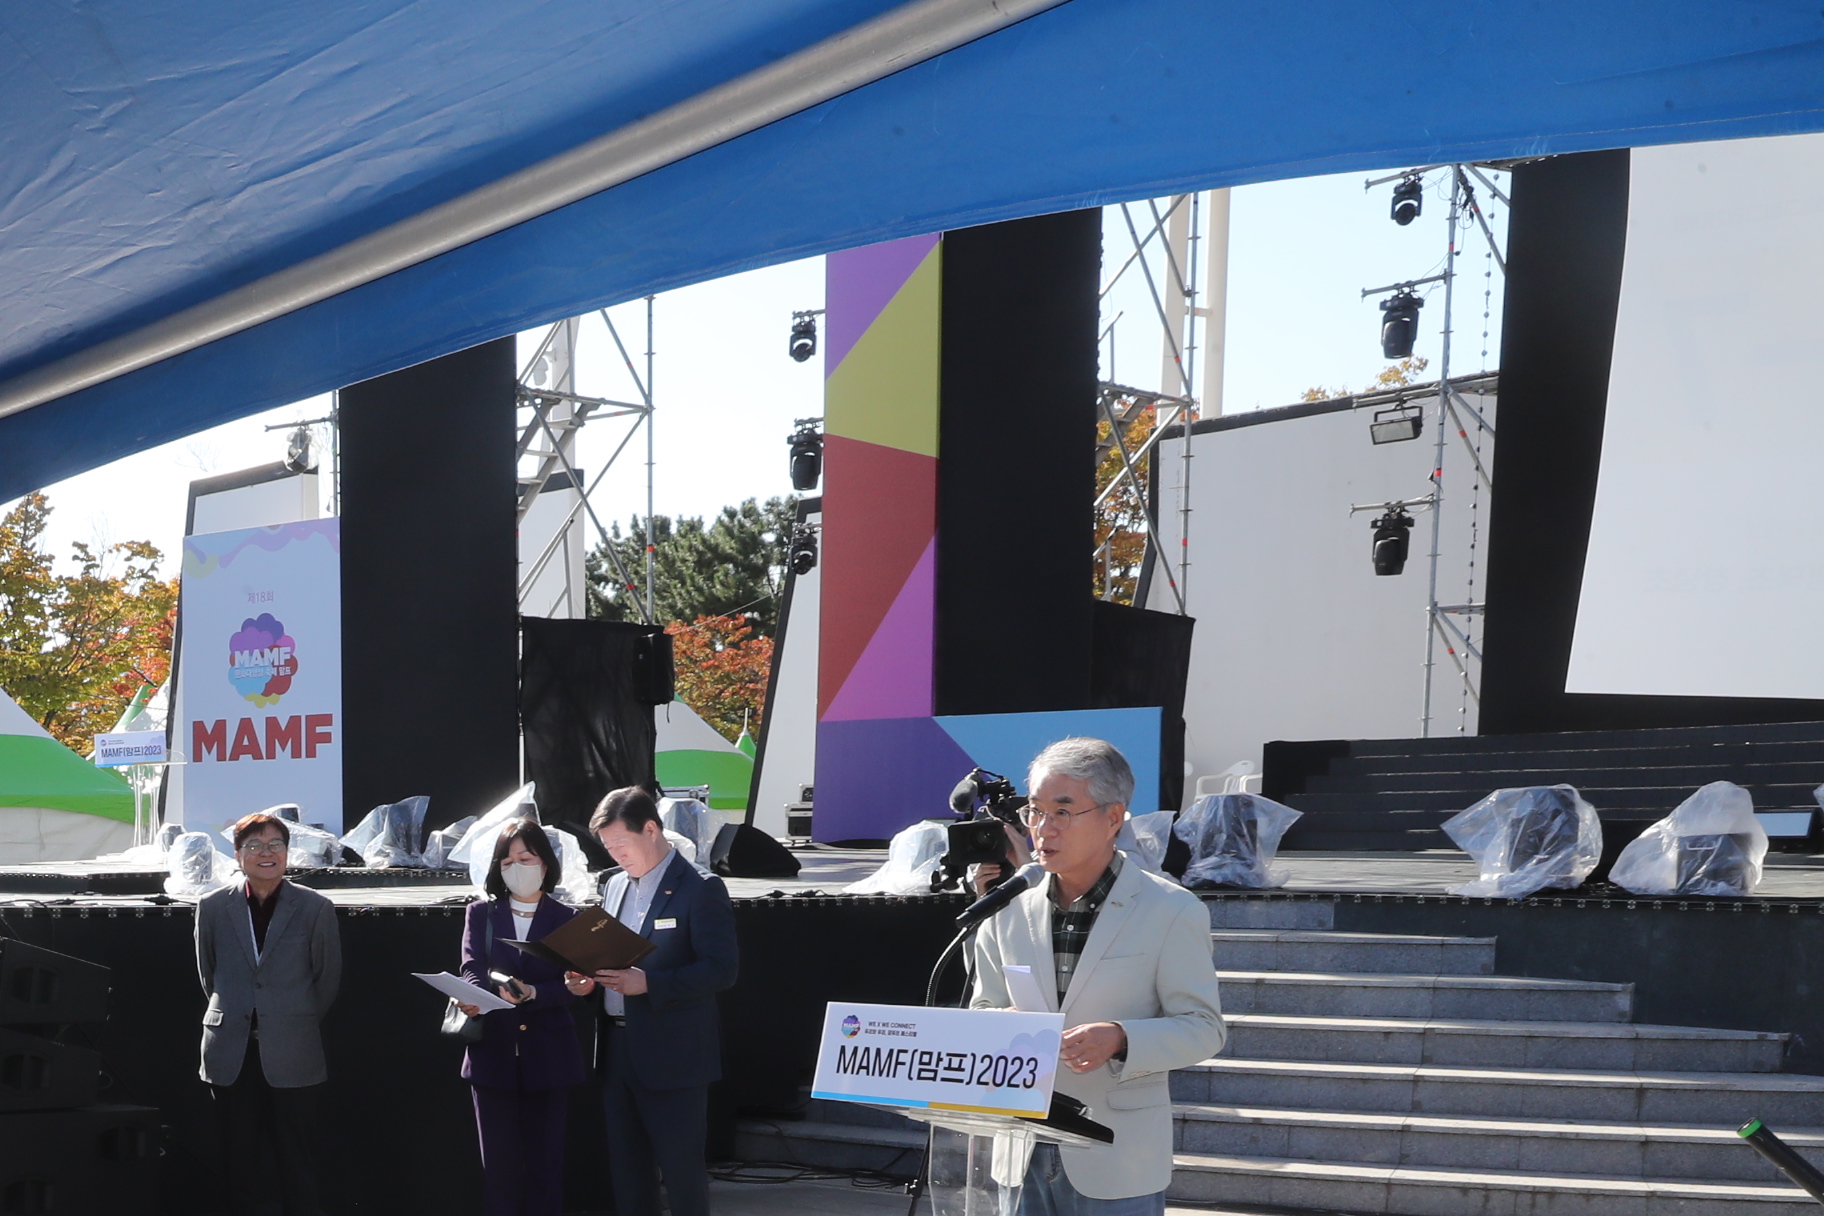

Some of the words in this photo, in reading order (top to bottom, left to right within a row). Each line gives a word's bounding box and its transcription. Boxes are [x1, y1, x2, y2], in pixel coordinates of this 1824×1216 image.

[247, 590, 274, 604] 제18회
[234, 646, 292, 668] MAMF
[192, 713, 333, 763] MAMF
[101, 744, 162, 758] MAMF(맘프)2023
[835, 1045, 1039, 1090] MAMF(맘프)2023
